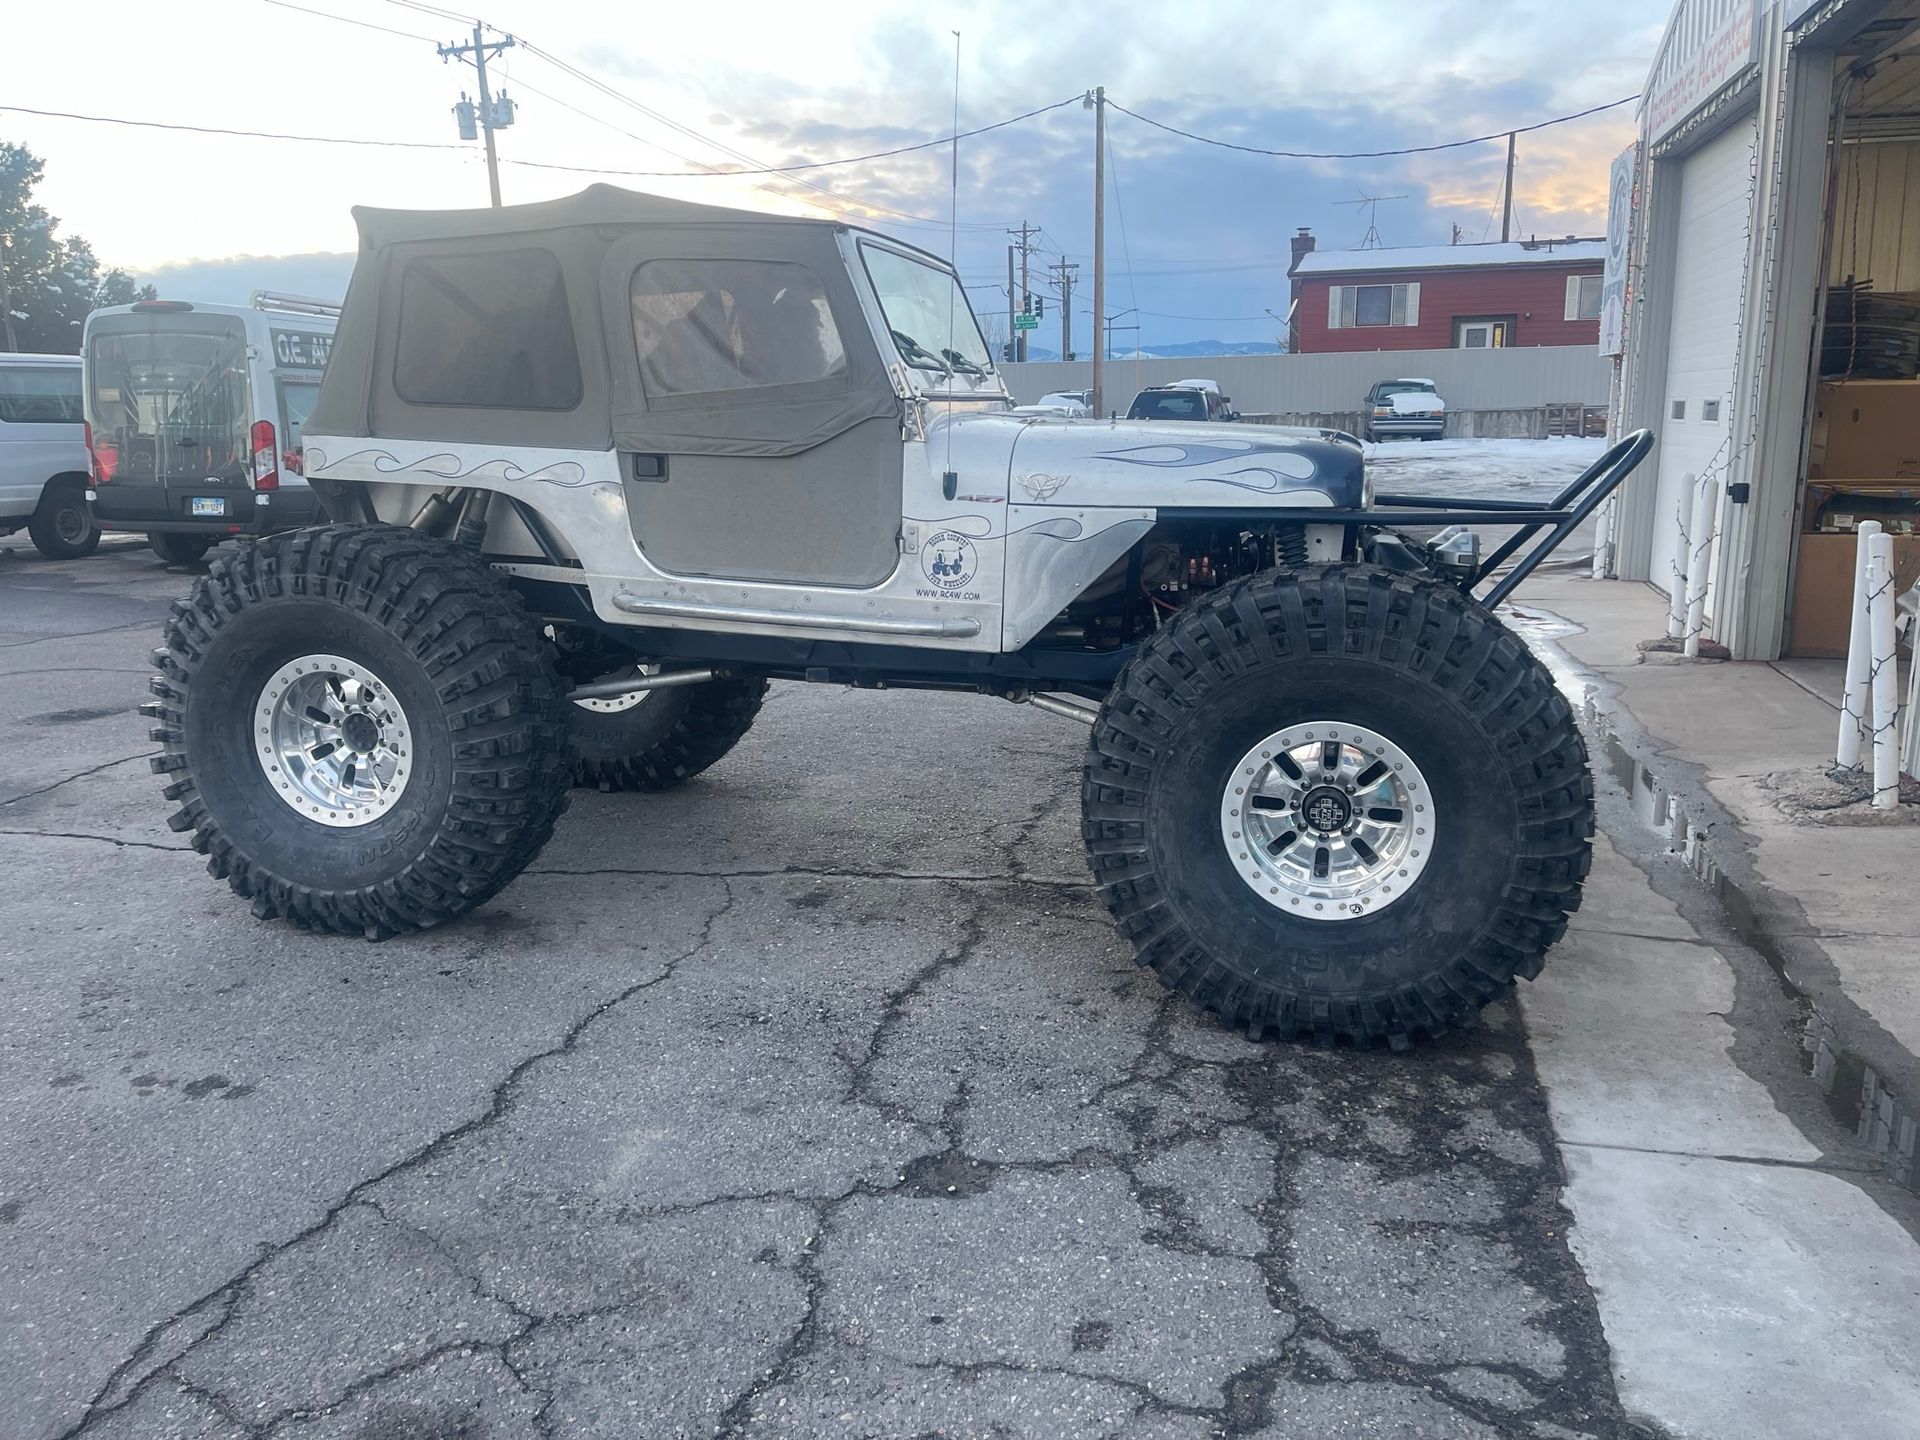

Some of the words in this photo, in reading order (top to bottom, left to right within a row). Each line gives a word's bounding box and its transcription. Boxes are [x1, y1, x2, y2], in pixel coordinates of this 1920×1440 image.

[929, 534, 946, 547] ROUGH
[946, 533, 969, 548] COUNTRY
[928, 573, 942, 585] FOUR
[943, 573, 970, 587] WHEELERS
